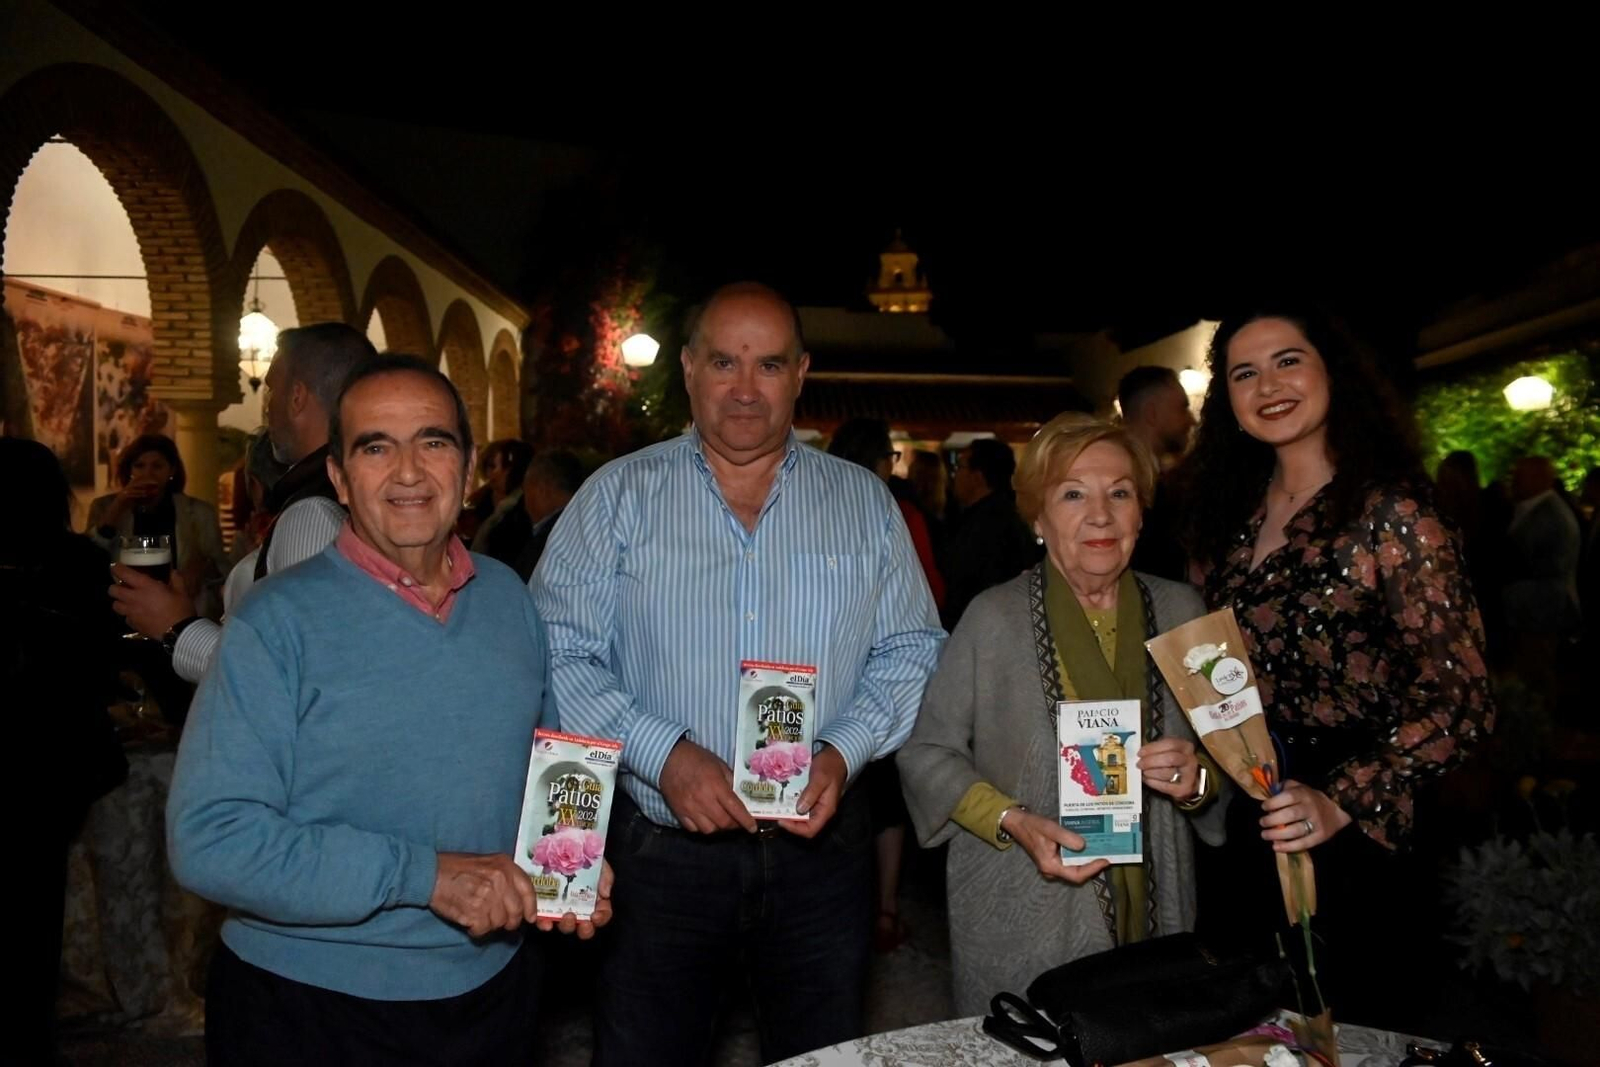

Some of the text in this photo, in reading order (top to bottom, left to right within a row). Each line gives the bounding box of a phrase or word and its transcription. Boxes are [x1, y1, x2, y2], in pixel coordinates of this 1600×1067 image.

[758, 704, 804, 725] Patios
[1077, 717, 1120, 729] VIANA
[548, 782, 602, 809] Patios
[577, 810, 599, 822] 2024
